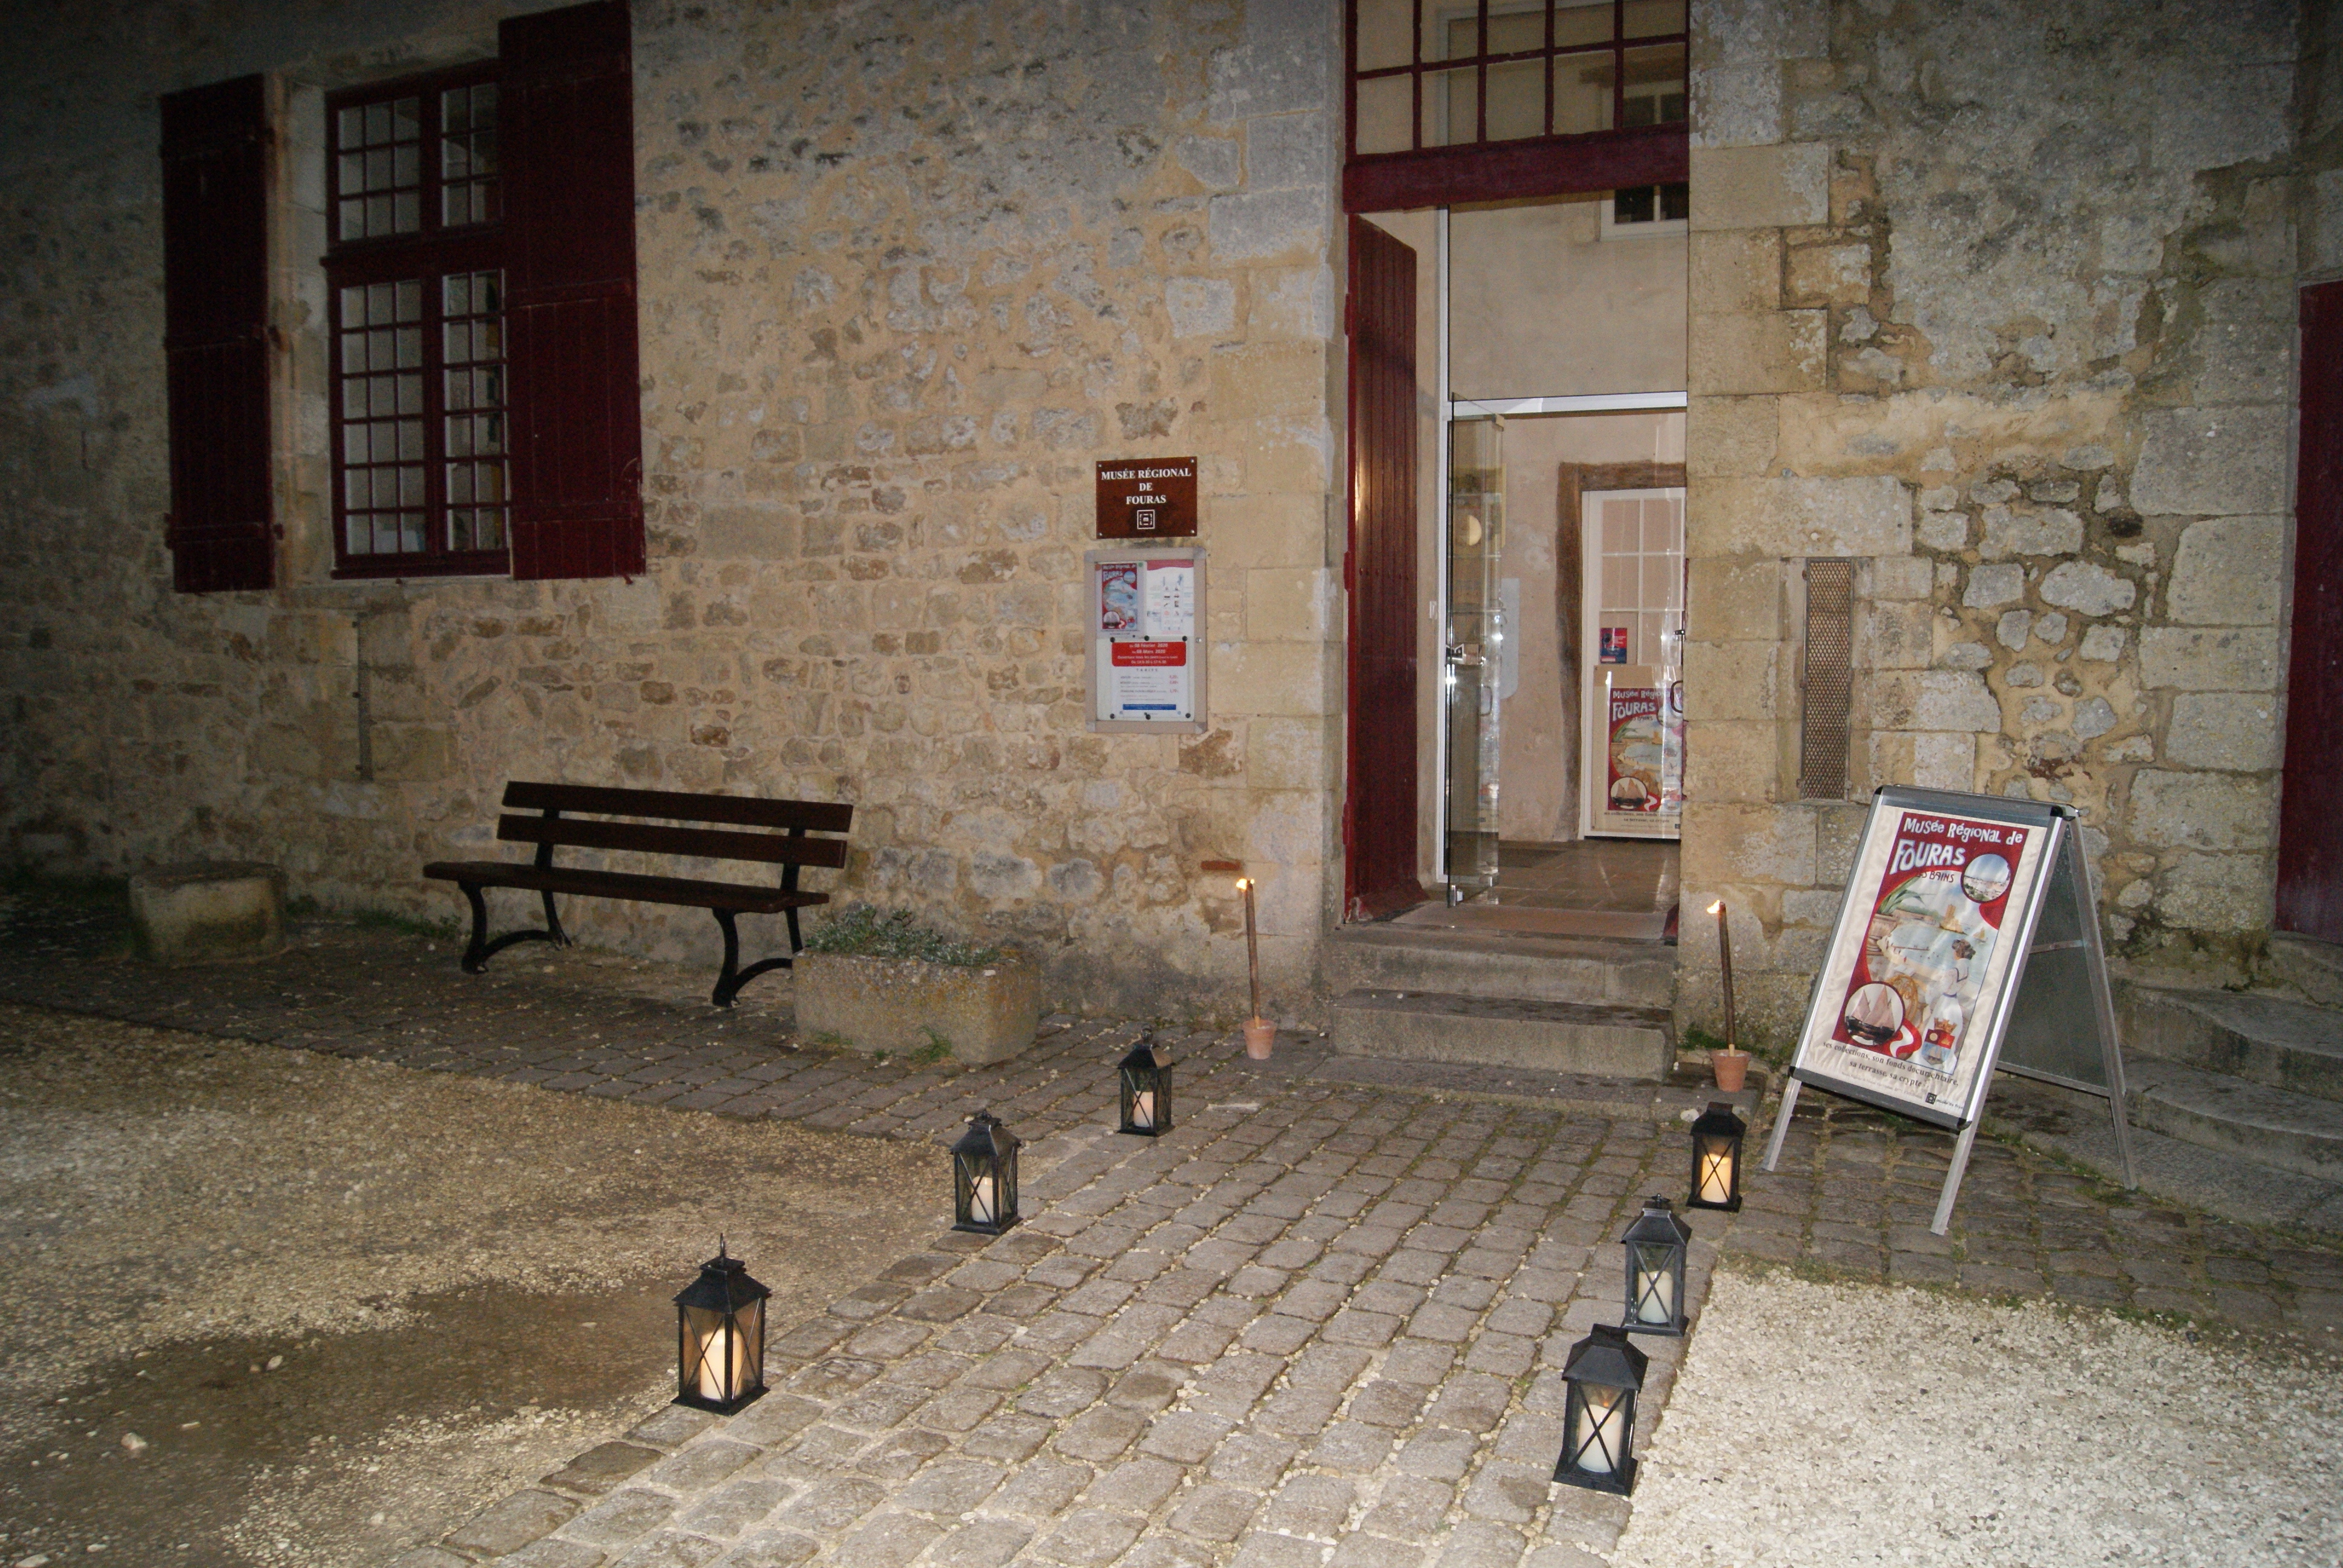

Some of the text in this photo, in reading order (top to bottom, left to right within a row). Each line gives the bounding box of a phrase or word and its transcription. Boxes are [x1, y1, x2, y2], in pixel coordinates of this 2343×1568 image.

[1101, 467, 1191, 480] MUSÉE RÉGIONAL
[1139, 482, 1153, 491] DE
[1126, 495, 1167, 505] FOURAS
[1613, 702, 1656, 721] FOURAS
[2005, 831, 2024, 846] de
[1889, 838, 1965, 875] FOURAS
[1929, 871, 1955, 883] BAINS
[1834, 1044, 1870, 1060] collections,
[1872, 1055, 1884, 1064] son
[1886, 1057, 1906, 1070] fonds
